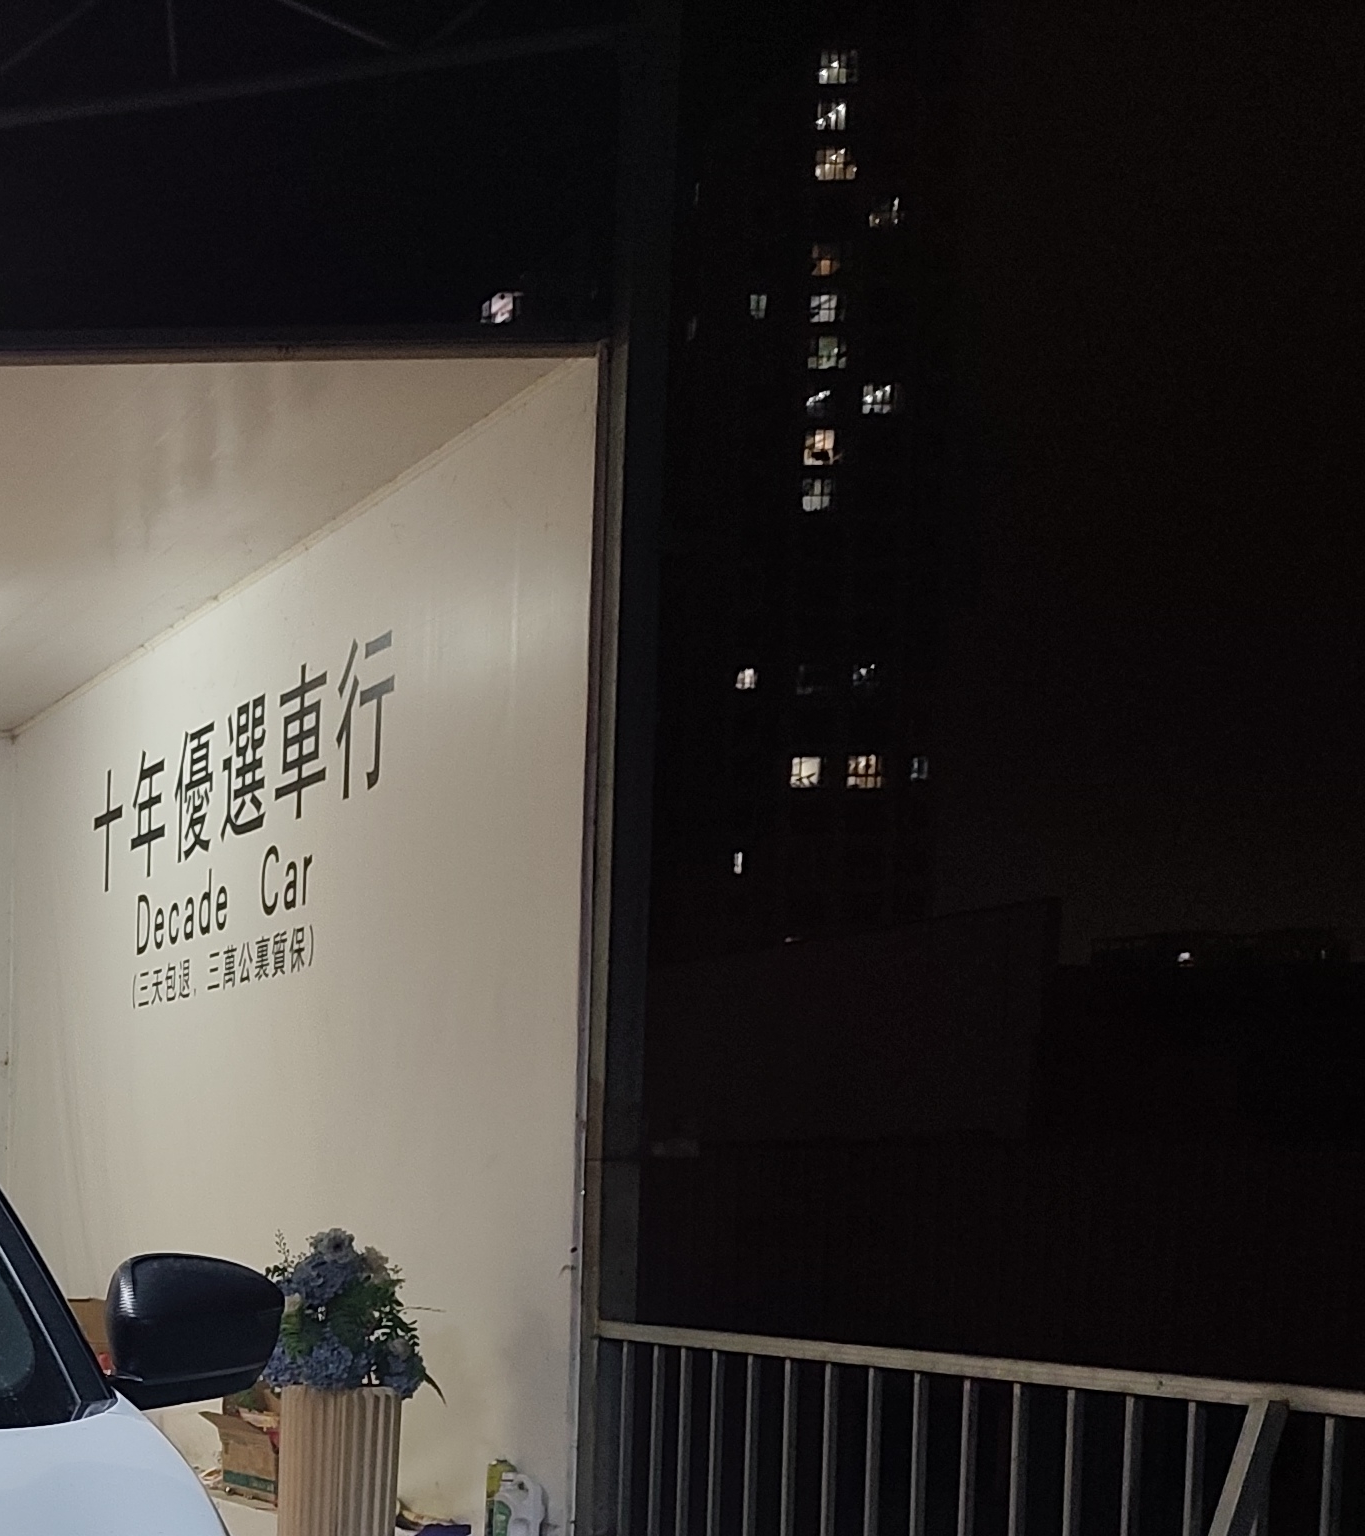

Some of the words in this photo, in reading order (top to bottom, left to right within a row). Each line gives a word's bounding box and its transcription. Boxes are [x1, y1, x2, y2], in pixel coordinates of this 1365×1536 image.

[93, 630, 395, 892] 十年優選車行
[136, 868, 228, 955] Decade
[260, 845, 313, 916] Car
